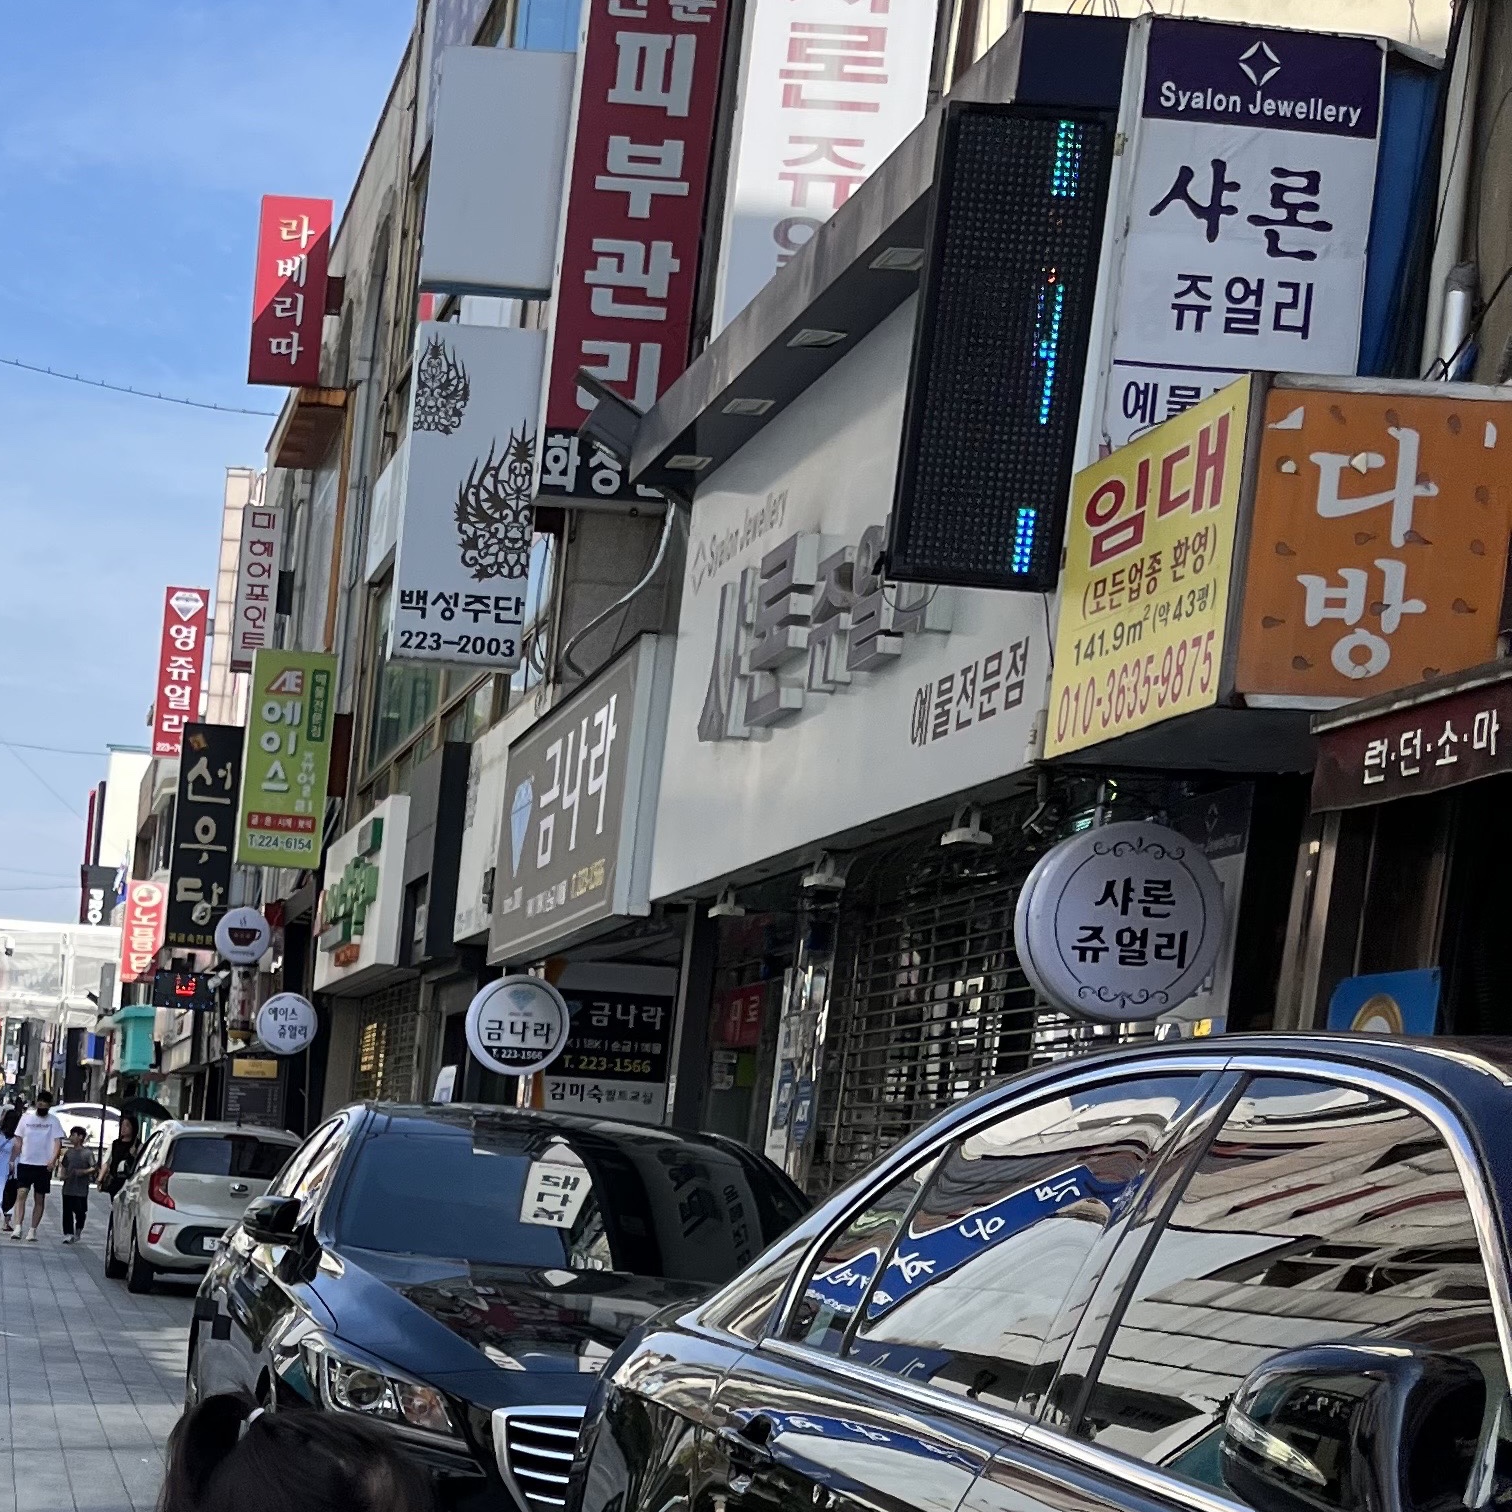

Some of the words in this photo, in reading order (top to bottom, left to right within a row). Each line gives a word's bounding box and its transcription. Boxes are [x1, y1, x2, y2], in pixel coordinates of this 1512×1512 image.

[1160, 80, 1241, 111] Syalon
[1249, 90, 1362, 127] Jewellery
[1149, 158, 1333, 261] 샤론
[268, 214, 315, 366] 라베리따
[1171, 273, 1314, 340] 쥬얼리
[1085, 411, 1231, 567] 임대
[1296, 427, 1439, 681] 다방
[399, 589, 525, 626] 백성주단
[399, 630, 516, 660] 223-2003
[910, 636, 1030, 747] 예물전문점
[1056, 630, 1216, 743] 010-3635-9875
[261, 700, 303, 792] 에이스
[536, 692, 618, 869] 금나라
[1094, 876, 1175, 918] 샤론
[1071, 926, 1189, 969] 쥬얼리
[268, 1006, 298, 1022] 에이스
[485, 1020, 552, 1045] 금나라
[590, 1002, 665, 1031] 금나라
[562, 1054, 575, 1069] T.
[578, 1055, 651, 1074] 223-1566
[550, 1082, 603, 1104] 김미숙
